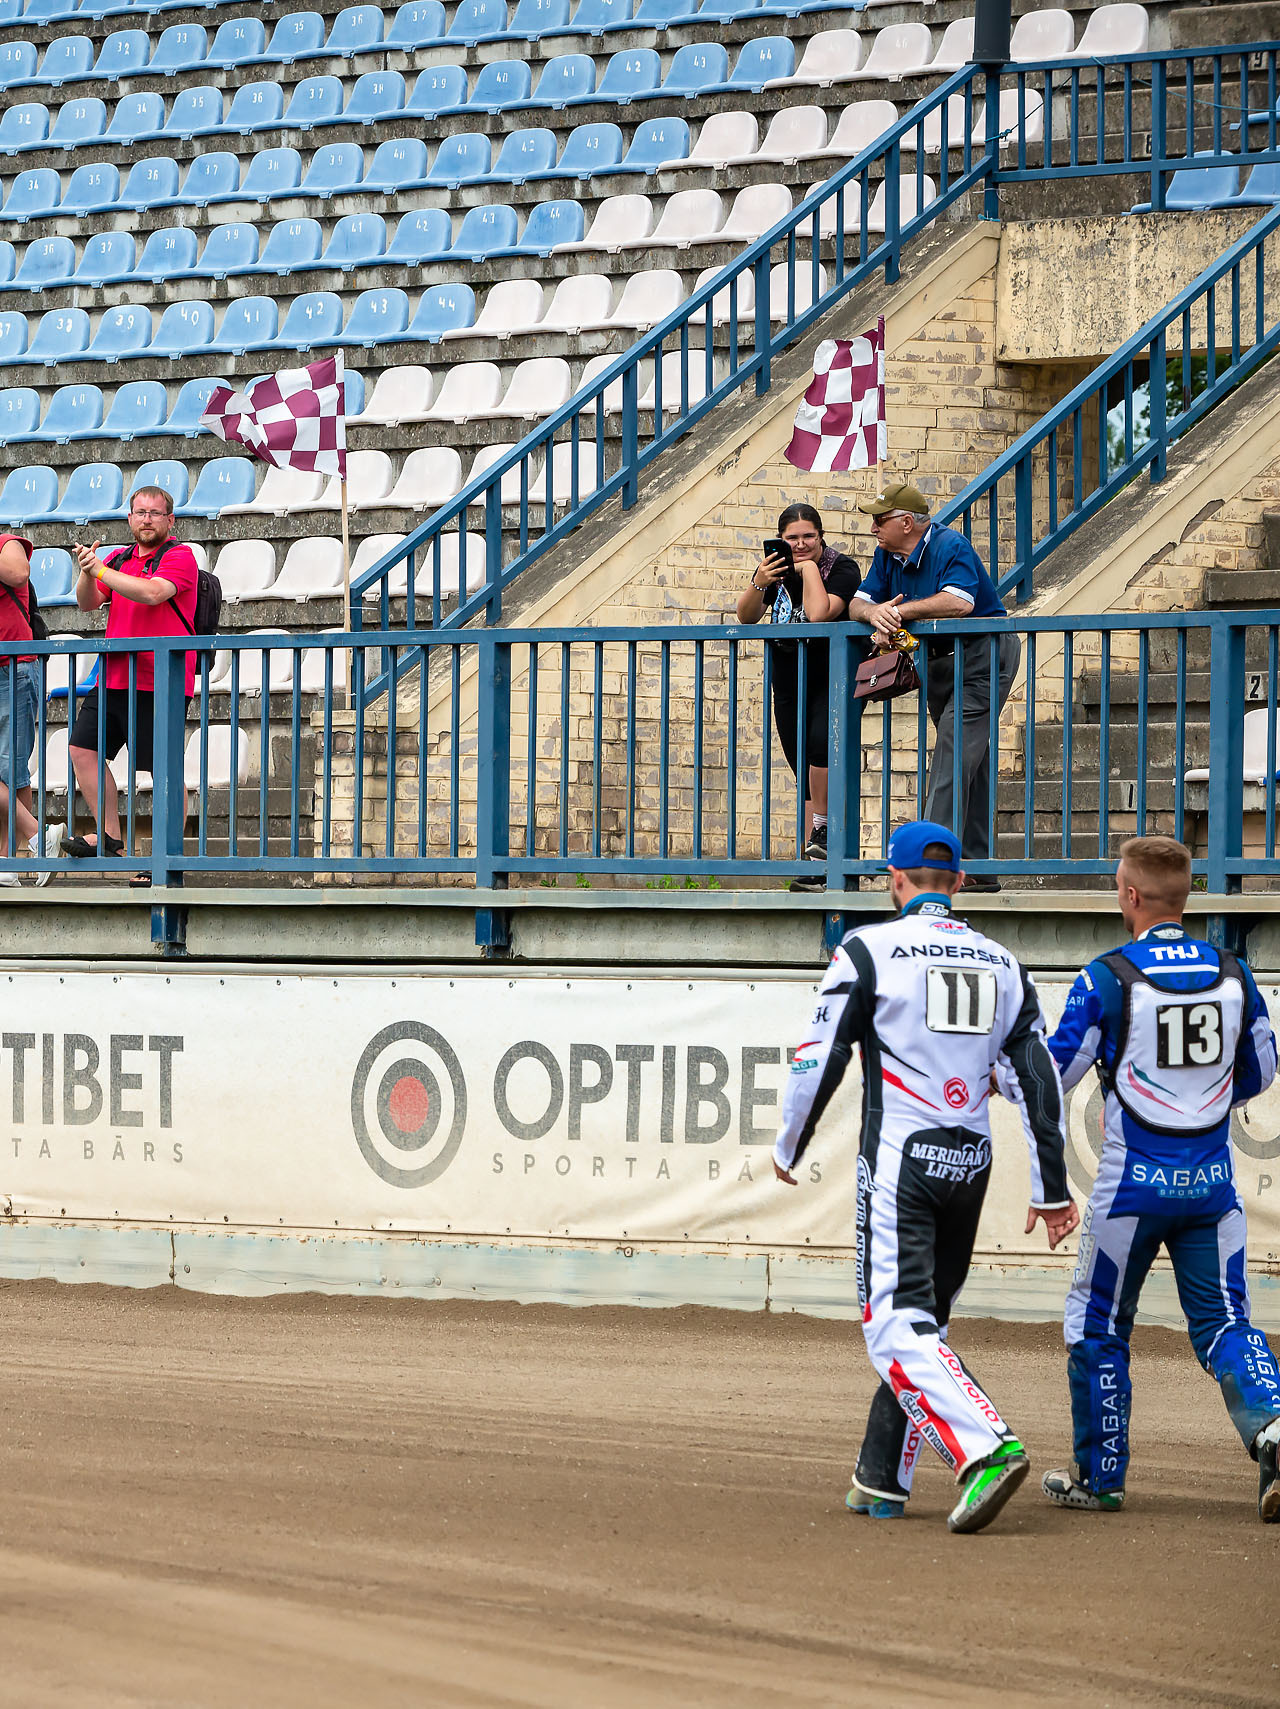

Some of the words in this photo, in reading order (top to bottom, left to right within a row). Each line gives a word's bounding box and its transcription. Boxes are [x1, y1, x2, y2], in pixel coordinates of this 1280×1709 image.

[180, 306, 200, 326] 40
[243, 309, 260, 323] 41
[305, 301, 324, 320] 42
[370, 298, 388, 314] 43
[438, 296, 456, 312] 44
[56, 317, 73, 333] 38
[115, 314, 135, 330] 39
[1249, 675, 1261, 699] 2
[889, 944, 1011, 970] ANDERSEN
[1149, 945, 1199, 961] THJ
[940, 971, 980, 1027] 11
[1159, 1003, 1221, 1066] 13
[493, 1040, 796, 1146] OPTIBE
[82, 1135, 184, 1164] BĀRS
[909, 1142, 984, 1167] MERIDIAN
[492, 1152, 671, 1181] SPORTA
[708, 1155, 822, 1185] BĀS
[924, 1160, 968, 1183] LIFTS
[1131, 1161, 1230, 1187] SAGARI
[1159, 1187, 1209, 1197] SPORTS
[1098, 1363, 1120, 1472] SAGARI
[922, 1422, 957, 1467] MERIDIAN
